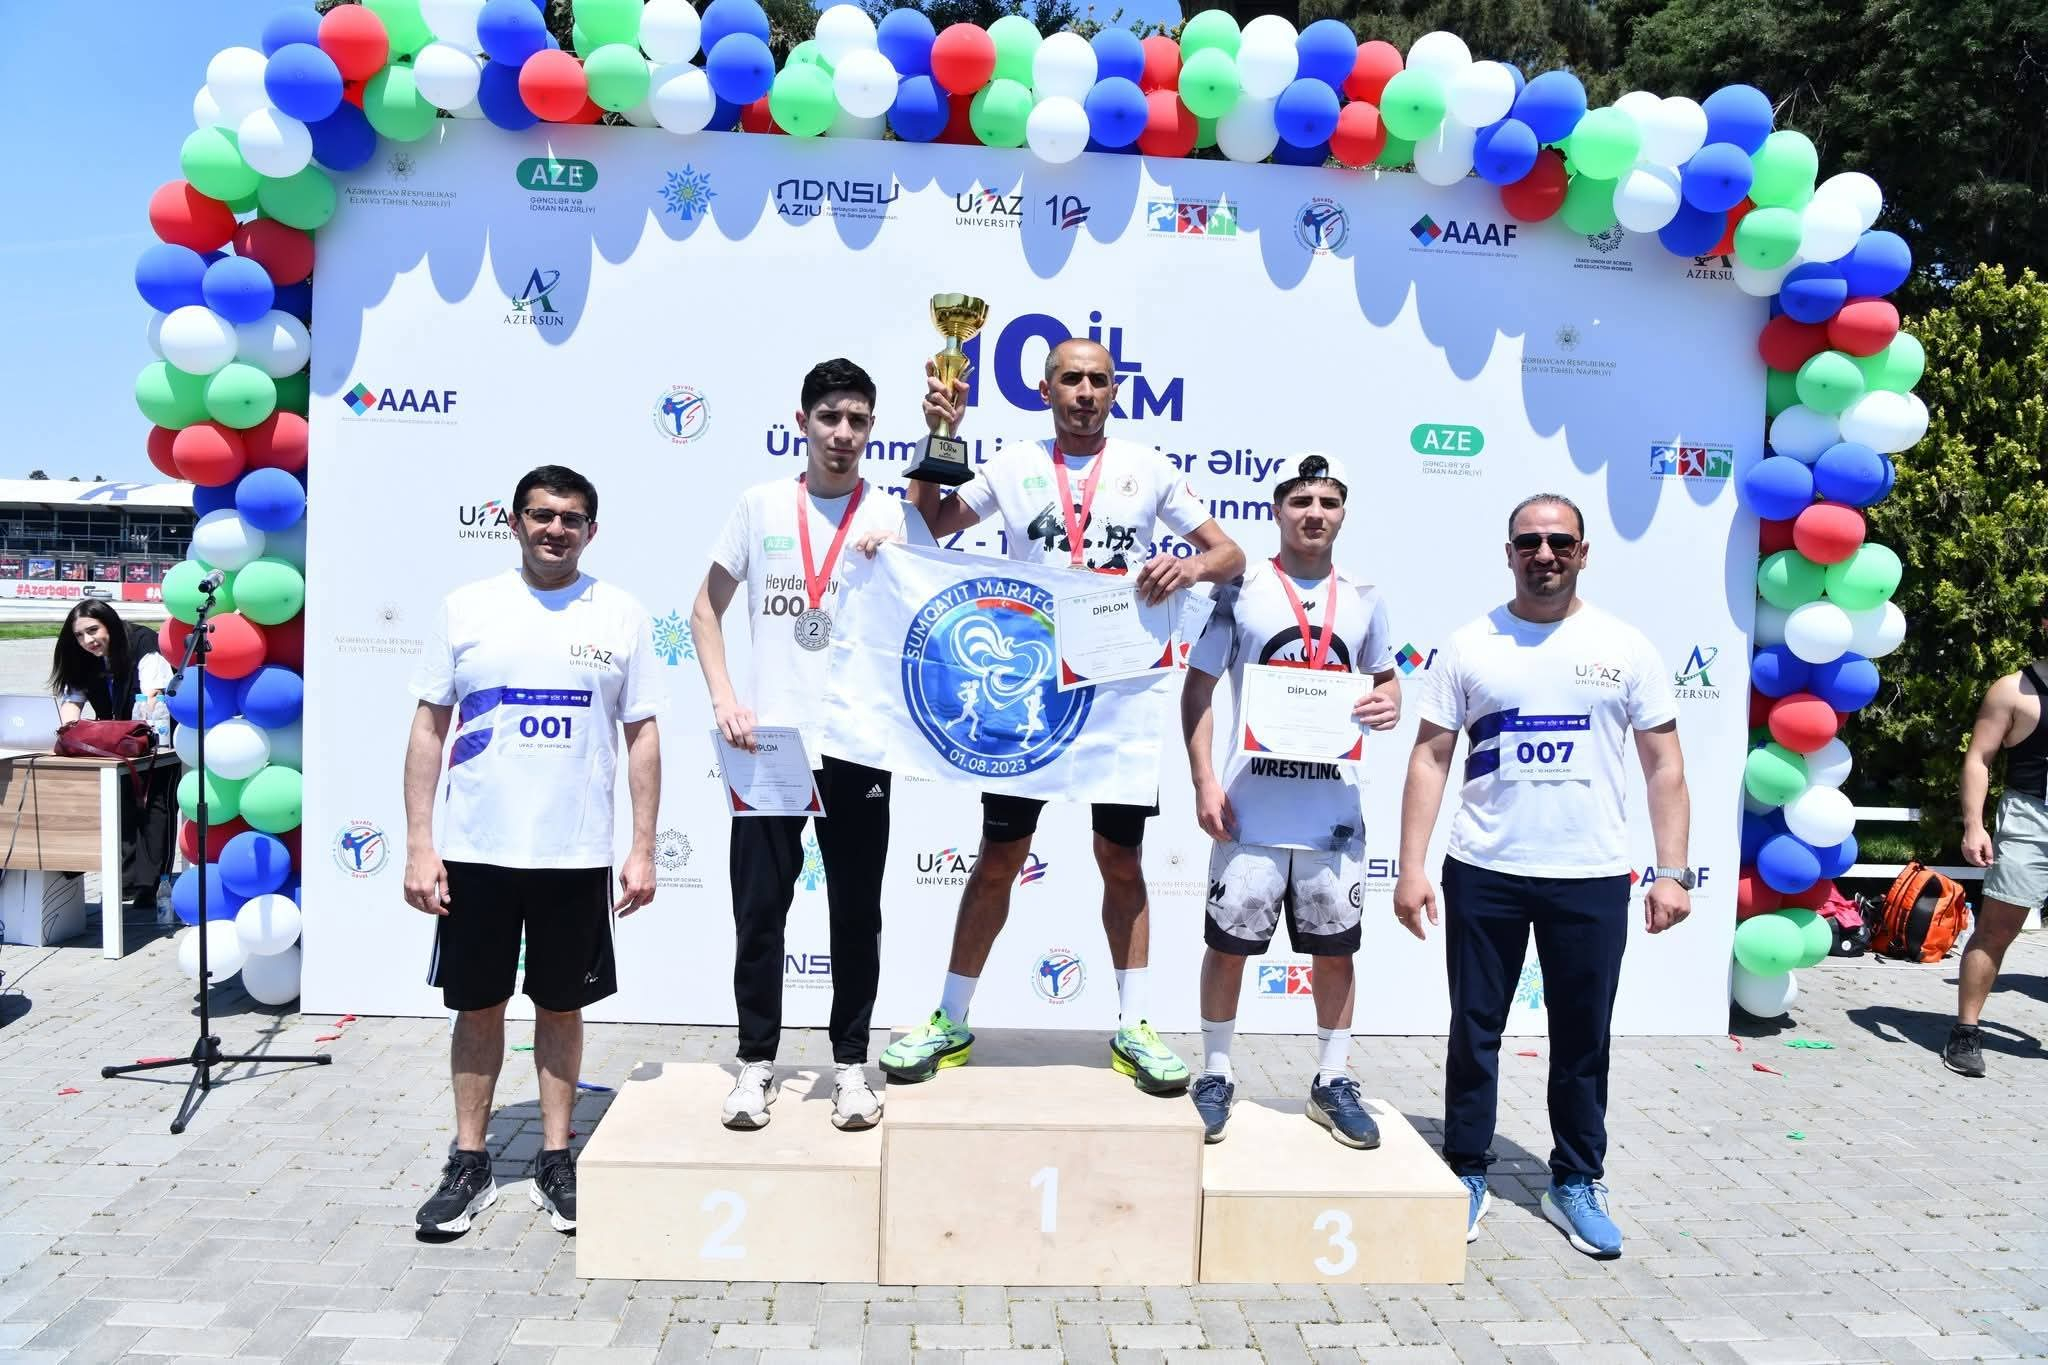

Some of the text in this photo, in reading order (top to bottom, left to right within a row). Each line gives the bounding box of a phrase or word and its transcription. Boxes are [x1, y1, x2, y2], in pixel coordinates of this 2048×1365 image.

[530, 164, 583, 187] AZE
[777, 203, 822, 217] AZIU
[955, 217, 1023, 229] UNIVERSITY
[1442, 220, 1517, 247] AAAF
[1686, 269, 1734, 281] AZERSU
[503, 314, 564, 327] AZERSUN
[377, 388, 457, 413] AAAF
[1423, 429, 1472, 451] AZE
[460, 499, 510, 527] UFA
[459, 530, 512, 540] UNIVERSI
[16, 584, 80, 598] #Azerbaijan
[762, 595, 805, 617] 100
[1092, 602, 1129, 616] DİPLOM
[809, 622, 819, 636] 2
[907, 580, 1055, 660] SUMQAYIT MARAFO
[1287, 684, 1327, 697] DİPLOM
[1674, 688, 1720, 700] ZERSUN
[520, 716, 571, 739] 001
[949, 750, 1027, 775] 01.08.2023
[1517, 741, 1574, 764] 007
[1251, 756, 1341, 781] WRESTLING
[1030, 1166, 1058, 1233] 1
[699, 1189, 748, 1260] 2
[1312, 1207, 1358, 1276] 3
